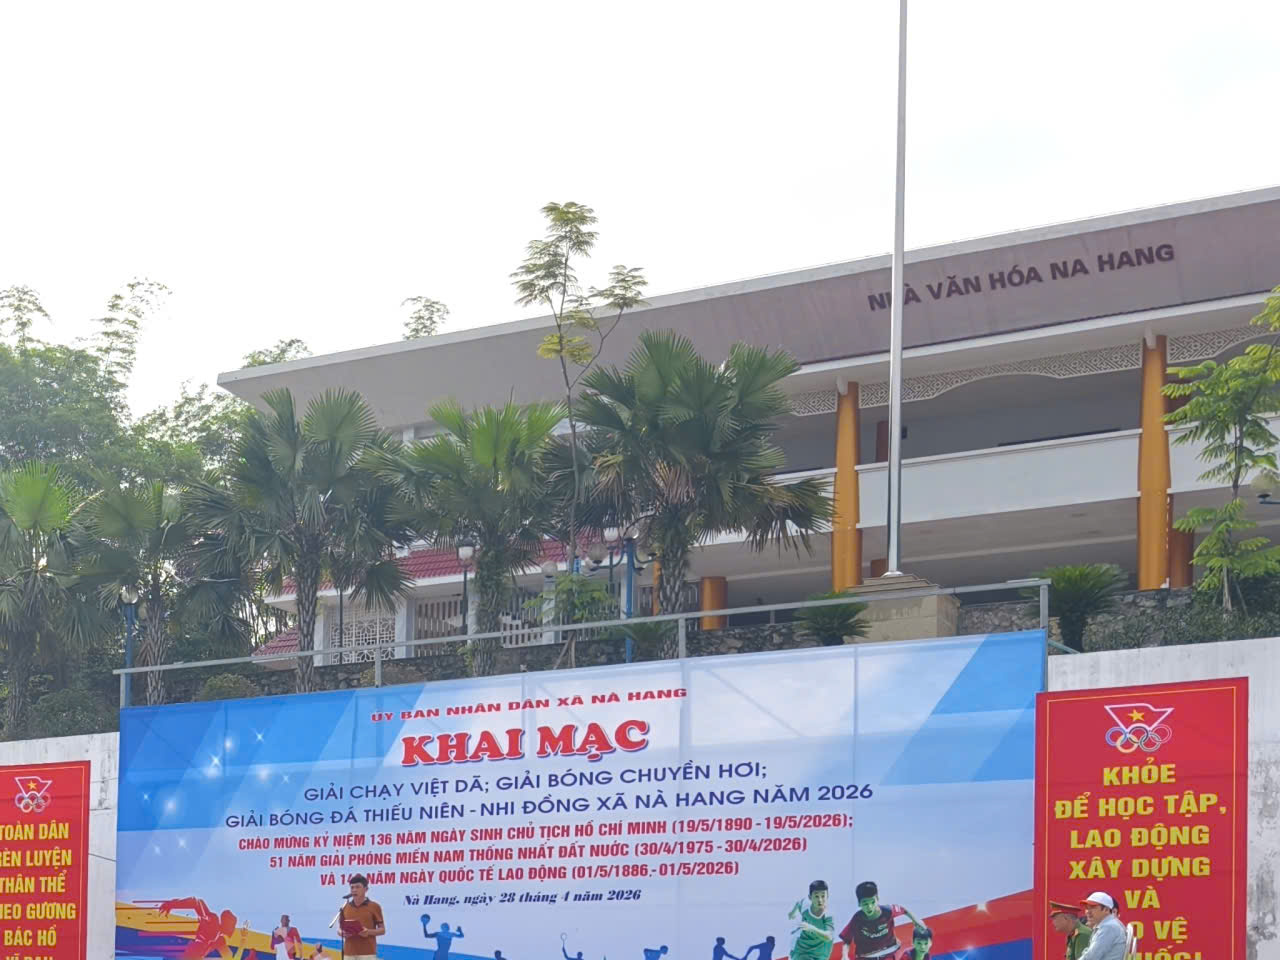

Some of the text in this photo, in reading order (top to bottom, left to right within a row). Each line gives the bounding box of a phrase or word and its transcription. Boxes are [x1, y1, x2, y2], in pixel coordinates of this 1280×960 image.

[926, 275, 981, 300] VĂN
[988, 264, 1044, 291] HÓA
[1049, 258, 1090, 281] NA
[1097, 243, 1175, 273] HANG
[401, 708, 440, 720] BAN
[446, 702, 501, 716] NHÂN
[508, 698, 550, 711] DÂN
[557, 695, 584, 708] XÃ
[591, 691, 620, 704] NÀ
[627, 688, 688, 702] HANG
[401, 719, 650, 767] KHAI MẠC
[304, 759, 768, 801] GIẢI CHẠY VIỆT DÃ; GIẢI BÓNG CHUYỀN HƠI;
[1103, 757, 1176, 786] KHỎE
[225, 809, 263, 828] GIẢI
[269, 808, 324, 826] BÓNG
[329, 806, 358, 824] ĐÁ
[363, 803, 413, 822] THIẾU
[419, 801, 465, 820] NIÊN
[480, 800, 515, 817] NHI
[521, 793, 590, 814] ĐỒNG
[596, 792, 628, 812] XÃ
[635, 789, 668, 809] NÀ
[675, 789, 745, 808] HANG
[753, 784, 810, 804] NĂM
[817, 783, 874, 802] 2026
[1054, 790, 1227, 820] ĐỂ HỌC TẬP,
[38, 820, 69, 839] DÂN
[238, 836, 270, 850] CHÀO
[274, 834, 310, 849] MỪNG
[313, 831, 330, 848] KỶ
[332, 831, 366, 849] NIỆM
[369, 833, 392, 846] 136
[396, 830, 427, 845] NĂM
[430, 827, 466, 843] NGÀY
[470, 828, 503, 842] SINH
[507, 821, 535, 840] CHỦ
[539, 824, 570, 842] TỊCH
[574, 820, 594, 837] HỒ
[598, 820, 623, 836] CHÍ
[627, 820, 667, 835] MINH
[765, 813, 854, 831] 19/5/2026);
[1070, 823, 1210, 850] LAO ĐỘNG
[25, 846, 72, 870] LUYỆN
[270, 856, 283, 868] 51
[288, 853, 316, 867] NĂM
[320, 849, 345, 867] GIẢI
[348, 851, 392, 866] PHÓNG
[433, 849, 465, 863] NAM
[469, 844, 513, 861] THỐNG
[517, 841, 555, 860] NHẤT
[558, 841, 585, 858] ĐẤT
[724, 837, 808, 853] 30/4/2026)
[39, 869, 67, 893] THỂ
[320, 872, 336, 887] VÀ
[339, 873, 365, 886] 14
[366, 870, 395, 884] NĂM
[399, 868, 435, 884] NGÀY
[438, 865, 475, 883] QUỐC
[479, 864, 494, 881] TẾ
[498, 867, 524, 881] LAO
[528, 864, 567, 883] ĐỘNG
[1069, 856, 1211, 881] XÂY DỰNG
[26, 901, 76, 920] GƯƠNG
[403, 894, 420, 906] Nà
[463, 892, 496, 907] ngày
[498, 892, 516, 903] 28
[518, 891, 558, 905] tháng
[573, 890, 603, 902] năm
[606, 889, 642, 902] 2026
[1124, 886, 1160, 909] VÀ
[4, 924, 57, 946] BÁC HỒ
[1153, 915, 1188, 944] VỆ
